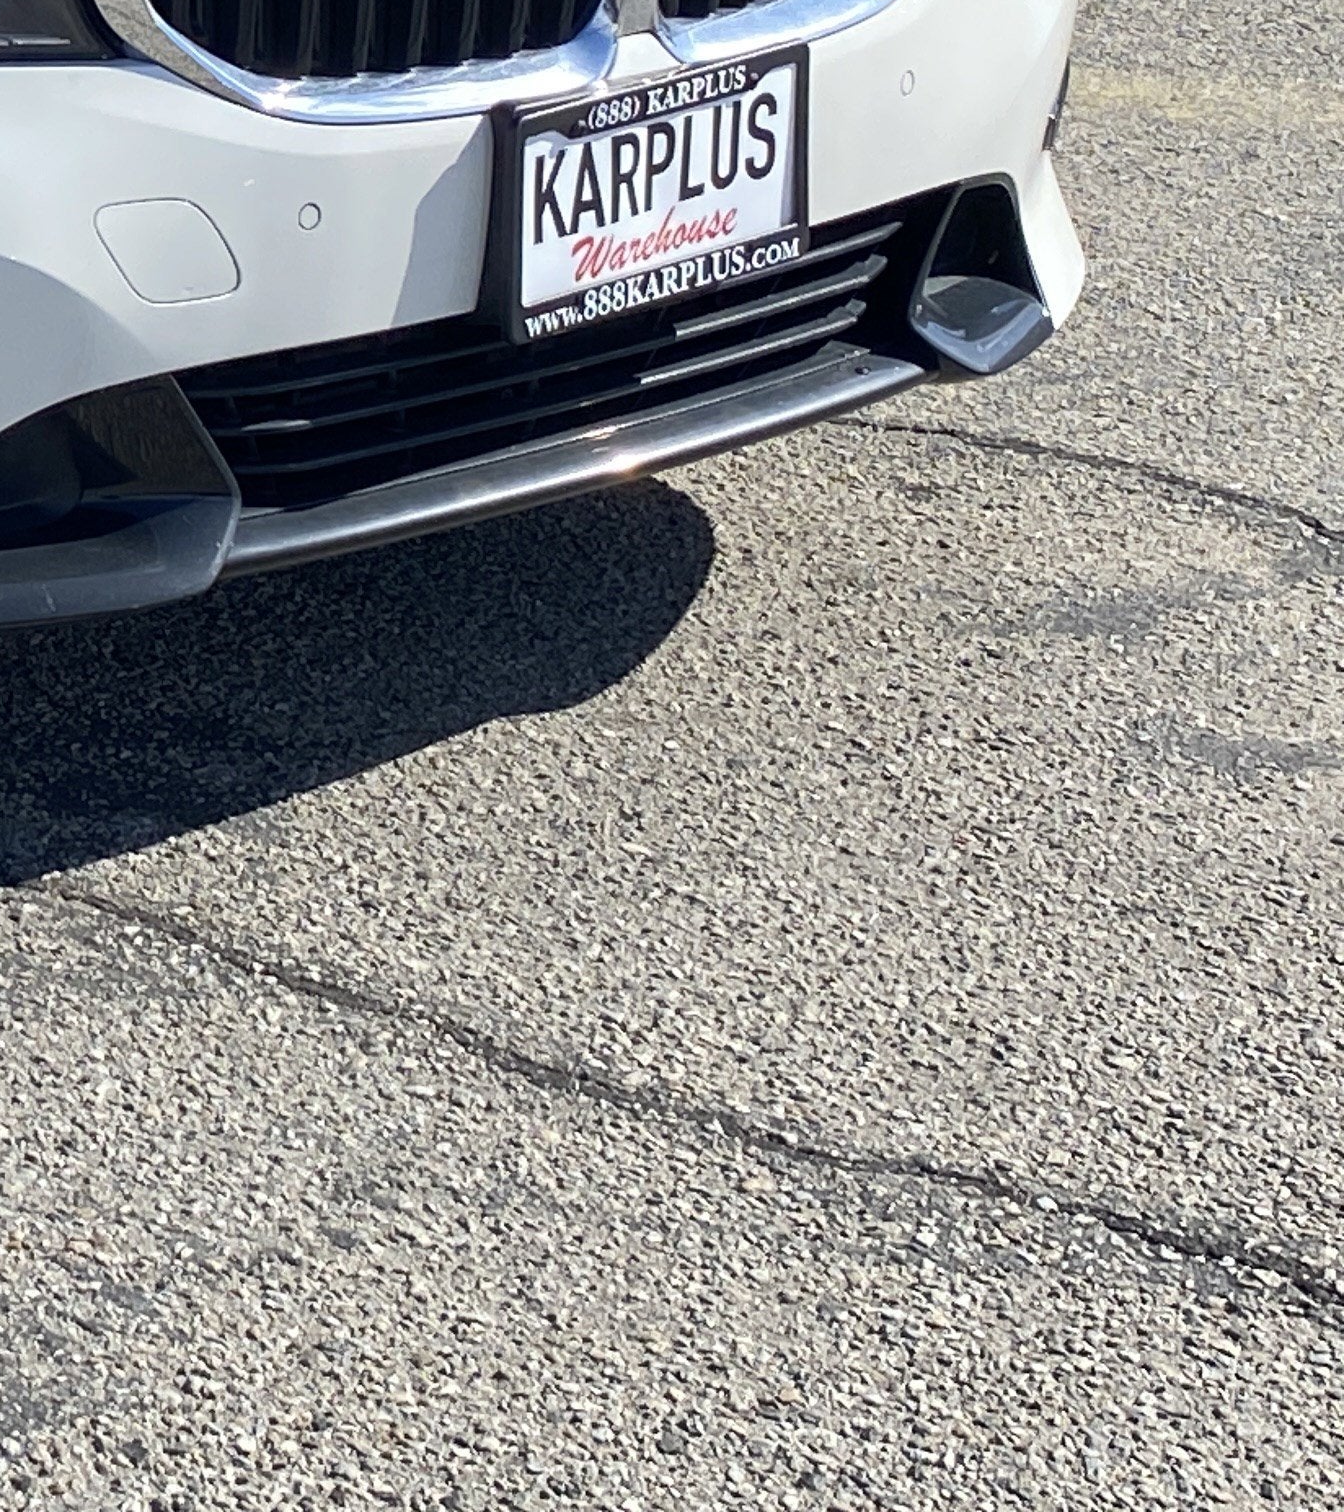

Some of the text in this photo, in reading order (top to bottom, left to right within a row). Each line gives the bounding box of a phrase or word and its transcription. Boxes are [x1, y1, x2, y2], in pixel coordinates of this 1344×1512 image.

[587, 64, 747, 130] (888) KARPLUS
[532, 91, 778, 246] KARPLUS
[570, 204, 739, 283] Warehouse
